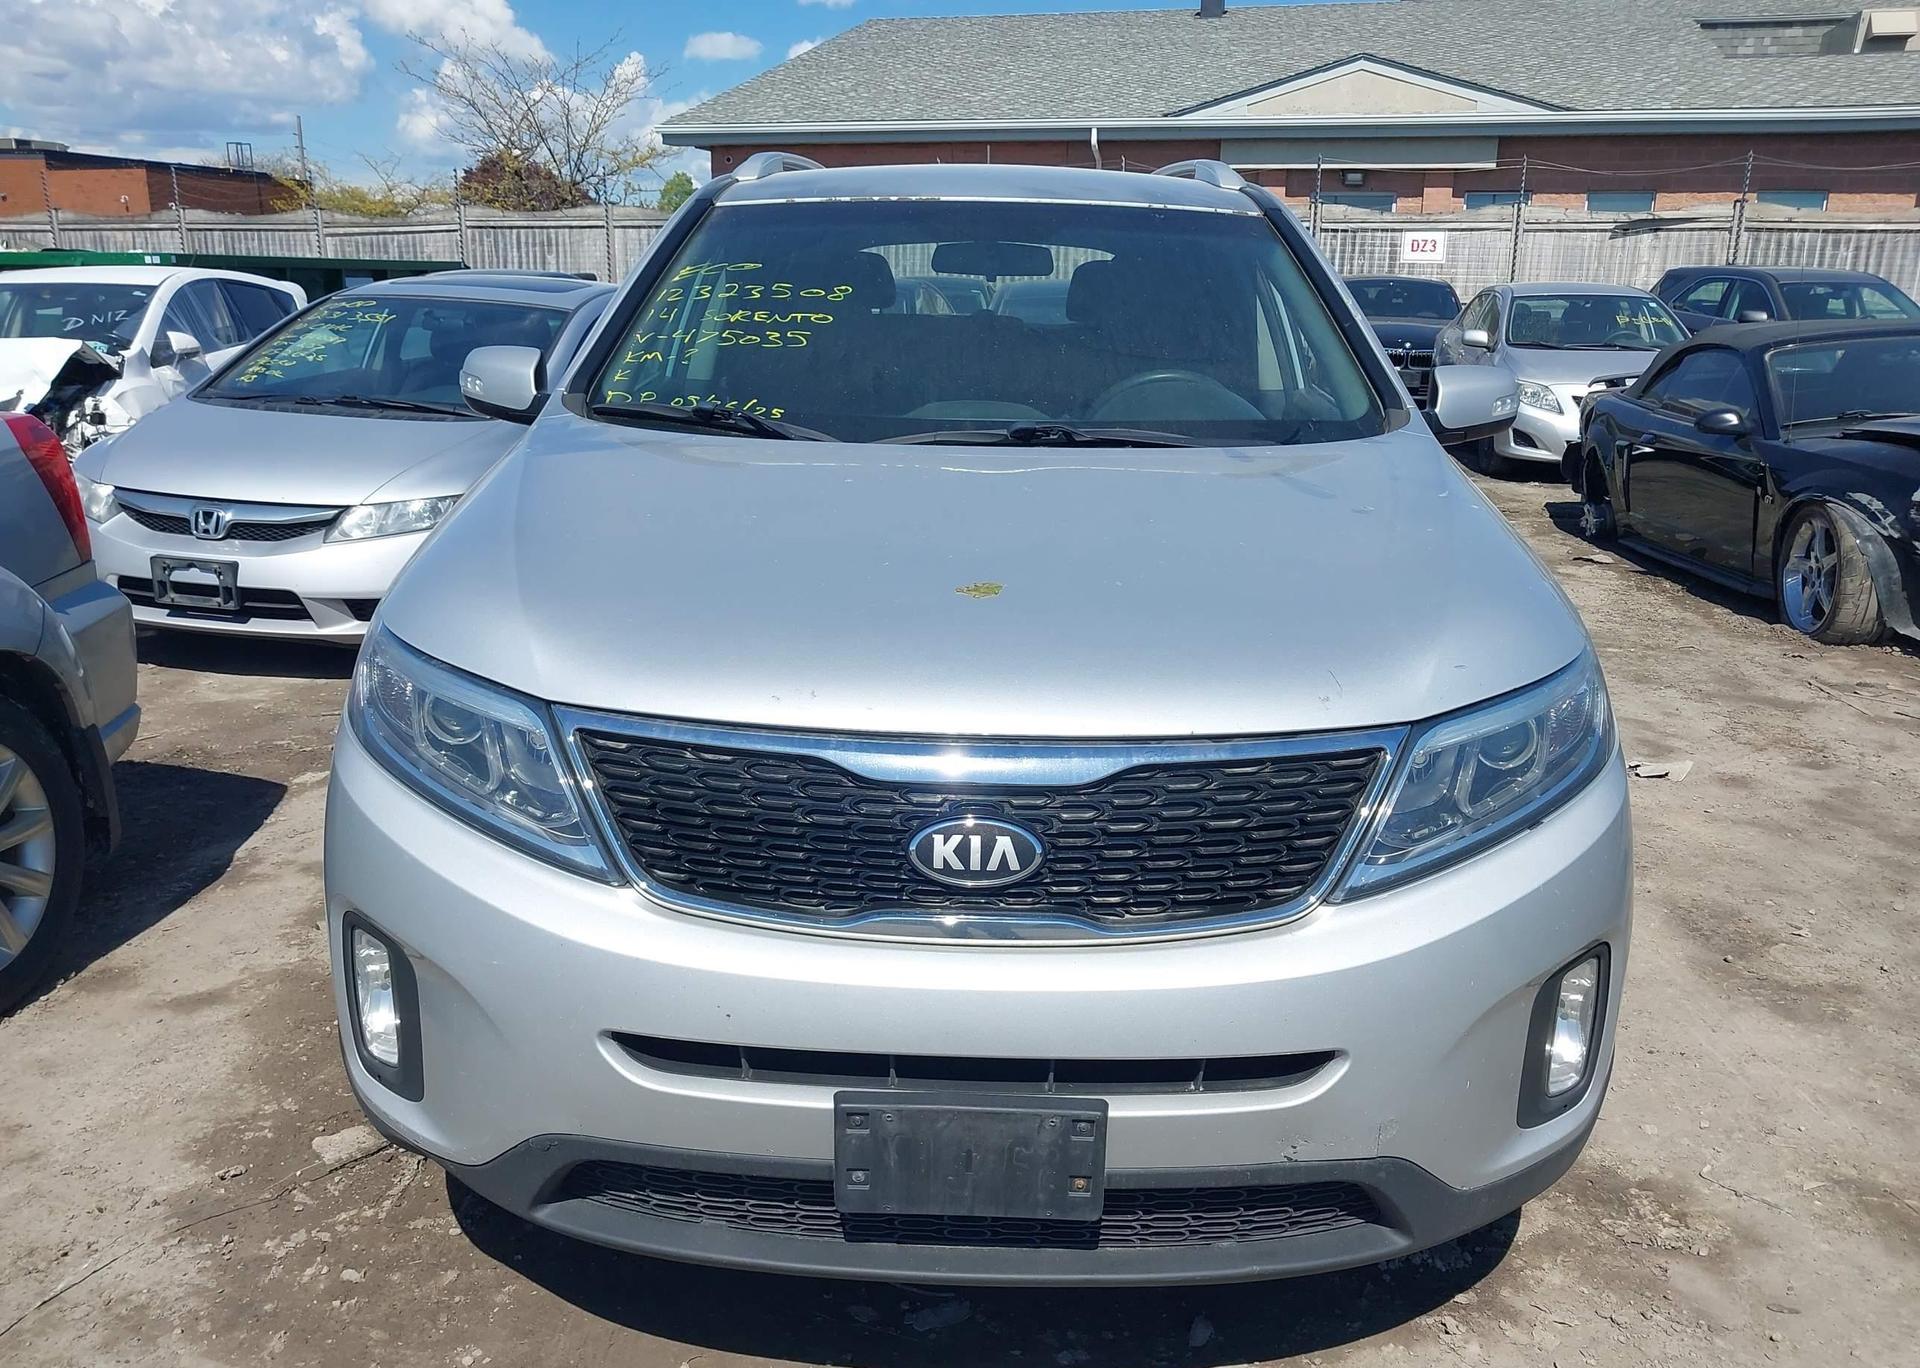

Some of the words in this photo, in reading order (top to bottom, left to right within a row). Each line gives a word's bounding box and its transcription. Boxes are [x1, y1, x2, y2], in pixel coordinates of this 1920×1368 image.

[1411, 239, 1437, 252] DZ3
[656, 283, 852, 301] 12323508
[701, 309, 833, 324] SORENTO
[932, 834, 1021, 871] KIA
